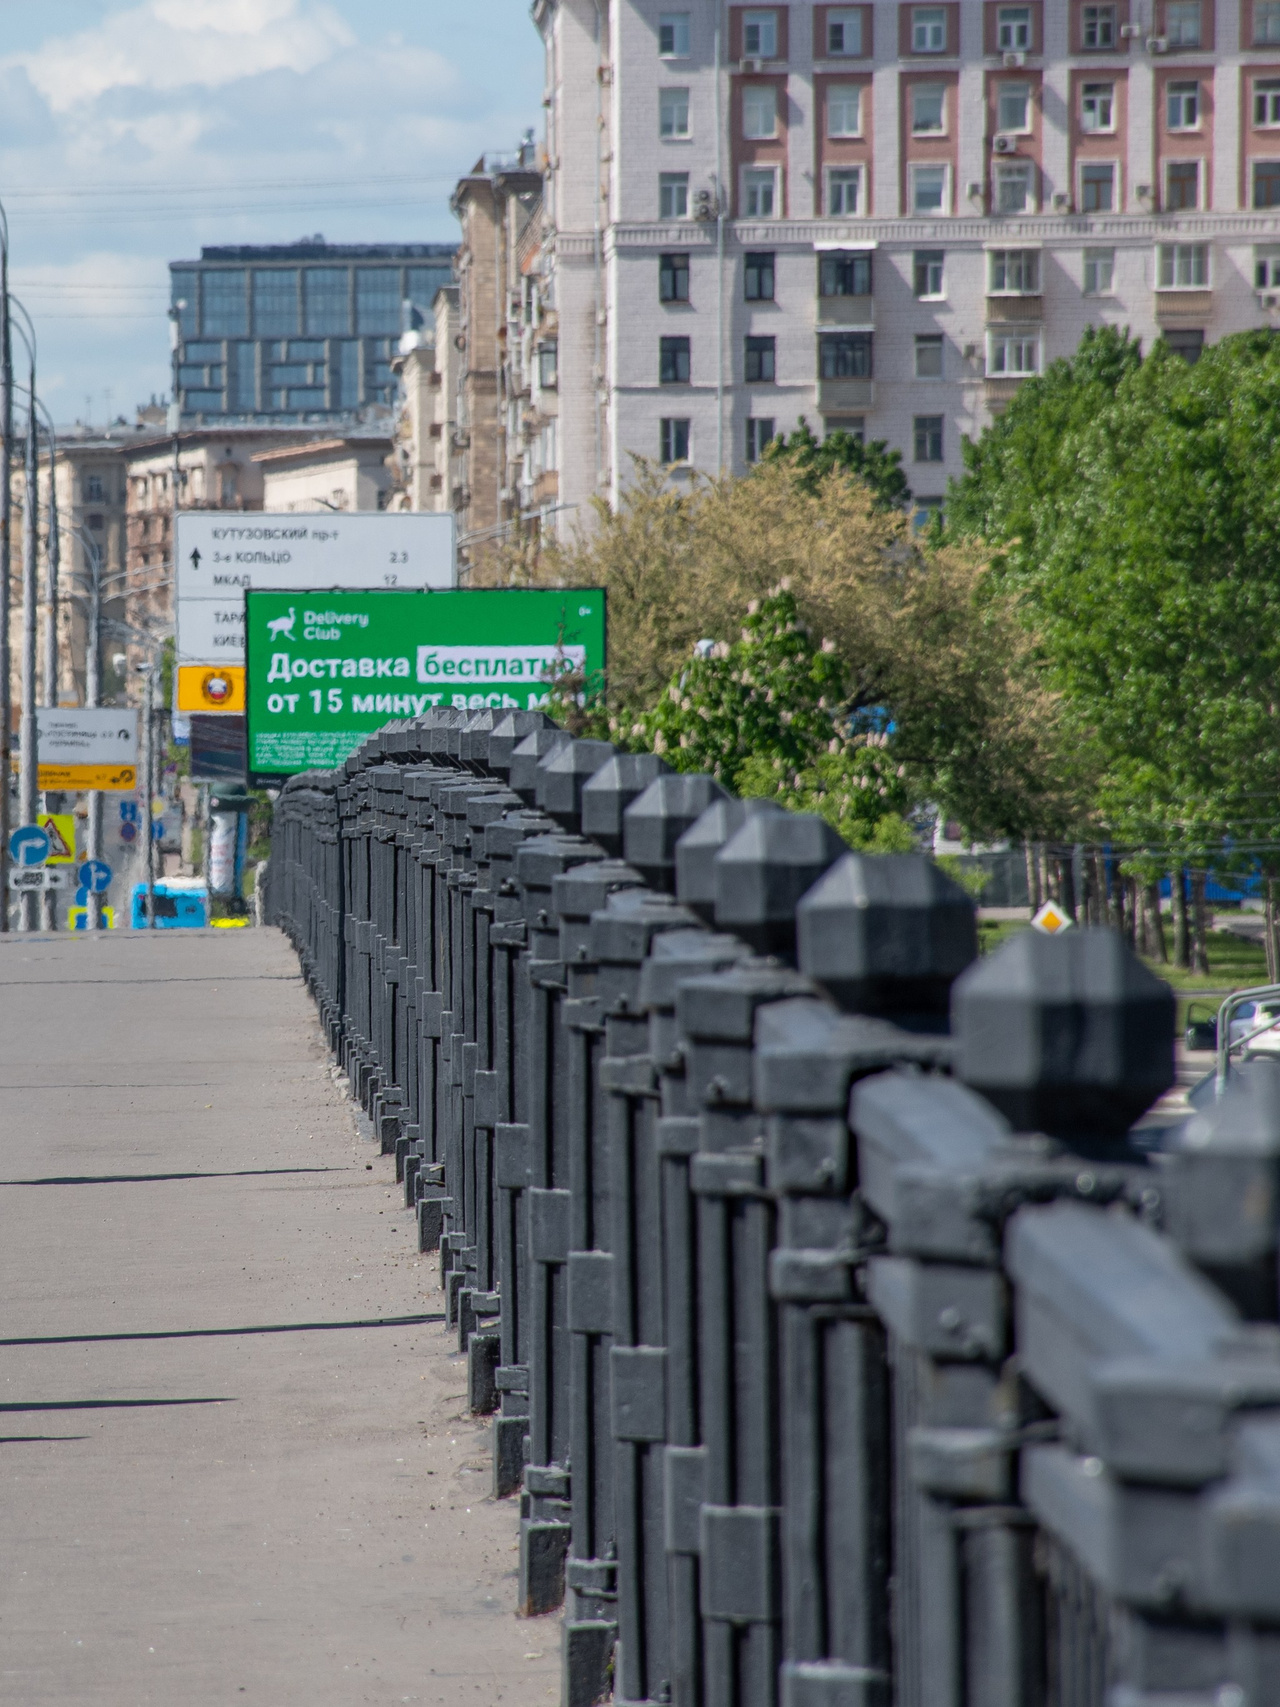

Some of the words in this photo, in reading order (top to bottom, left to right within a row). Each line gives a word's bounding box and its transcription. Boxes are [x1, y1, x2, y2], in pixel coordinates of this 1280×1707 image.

[211, 527, 308, 541] КУТУЗОВСКИЙ
[312, 529, 339, 543] пр-т
[235, 552, 292, 565] КОЛЬЦО
[389, 552, 409, 564] 2.3
[213, 574, 252, 587] МКАД
[384, 574, 398, 586] 12
[303, 611, 370, 628] Delivery
[303, 627, 341, 640] Club
[267, 652, 411, 683] Доставка
[267, 693, 300, 713] от
[309, 688, 343, 714] 15
[352, 692, 444, 718] минут
[451, 692, 520, 710] весь
